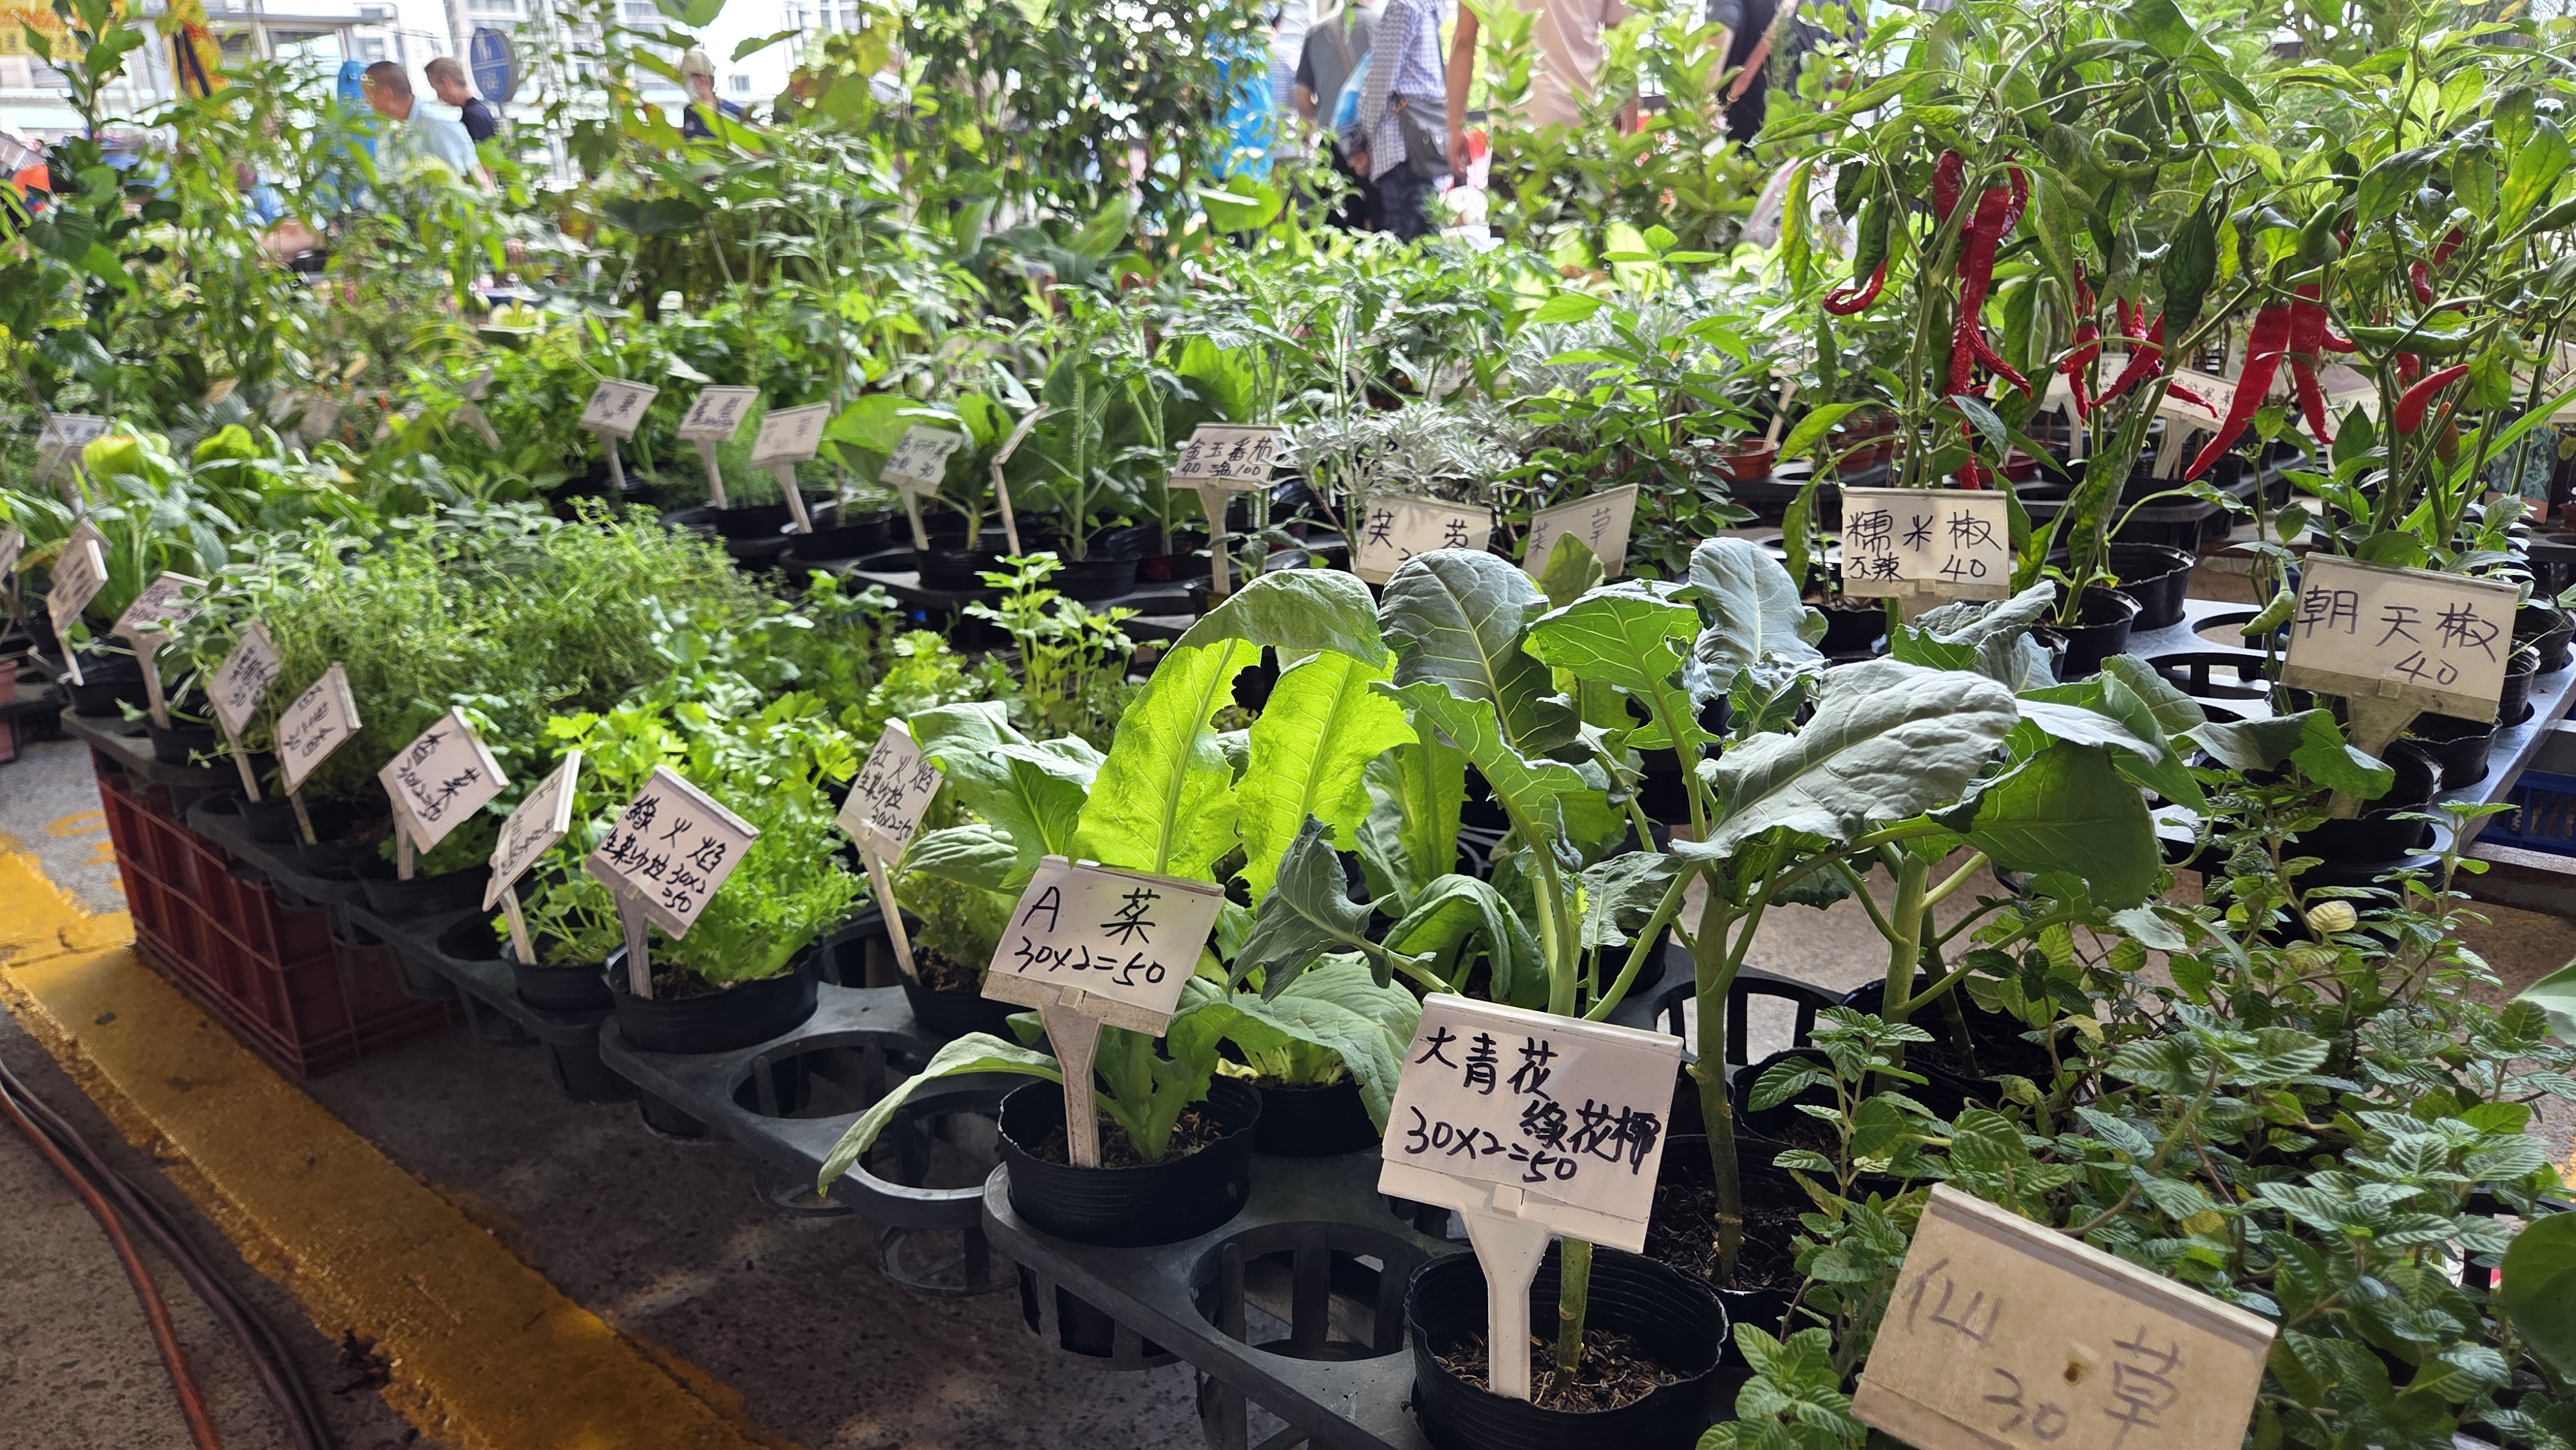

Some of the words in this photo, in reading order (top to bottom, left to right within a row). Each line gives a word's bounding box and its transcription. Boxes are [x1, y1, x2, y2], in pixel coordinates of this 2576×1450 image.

[1181, 462, 1202, 476] 40
[1845, 509, 2002, 557] 糯米椒
[1847, 552, 1904, 583] 不辣
[1940, 554, 1987, 581] 40
[2297, 584, 2500, 664] 朝天椒
[2394, 650, 2459, 686] 40
[411, 730, 482, 813] 香菜
[869, 741, 935, 794] 紅火焰
[625, 794, 727, 874] 綠火焰
[1414, 1026, 1558, 1101] 大青花
[1901, 1257, 2185, 1450] 仙草
[1983, 1367, 2069, 1442] 30
